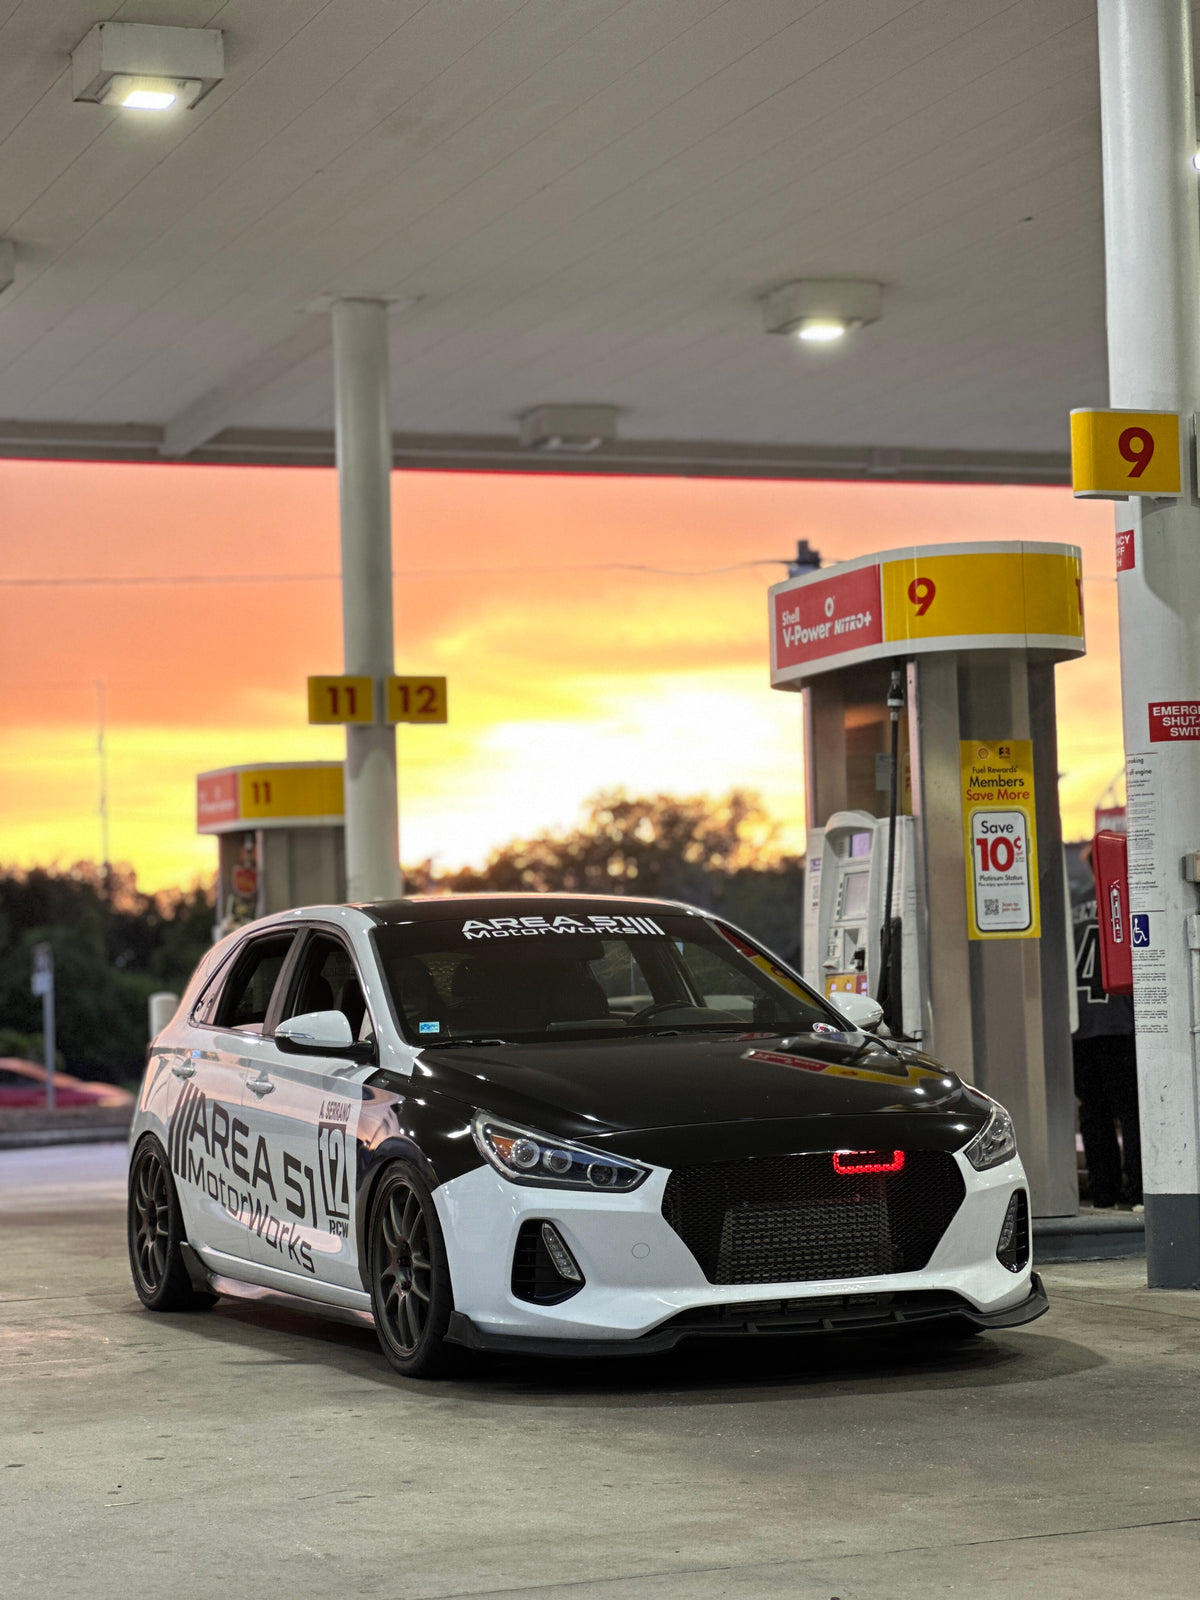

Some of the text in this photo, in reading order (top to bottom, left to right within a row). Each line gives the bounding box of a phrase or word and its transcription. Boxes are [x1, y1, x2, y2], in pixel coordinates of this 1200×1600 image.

[1118, 427, 1155, 478] 9
[908, 577, 936, 616] 9
[782, 607, 800, 626] Shell
[782, 623, 832, 648] V-Power
[327, 686, 356, 715] 11
[397, 684, 438, 714] 12
[1163, 717, 1200, 726] SHUT-
[972, 766, 985, 774] Fuel
[252, 781, 271, 804] 11
[969, 775, 1025, 788] Members
[966, 789, 1030, 801] Save More
[981, 820, 1014, 834] Save
[461, 915, 632, 932] AREA 51
[1113, 895, 1121, 939] FIRE
[464, 926, 638, 940] MotorWorks
[326, 1100, 351, 1122] SERRANO
[188, 1091, 317, 1229] AREA 51
[319, 1126, 349, 1217] 12
[188, 1148, 315, 1273] MotorWorks
[329, 1219, 349, 1238] RCW
